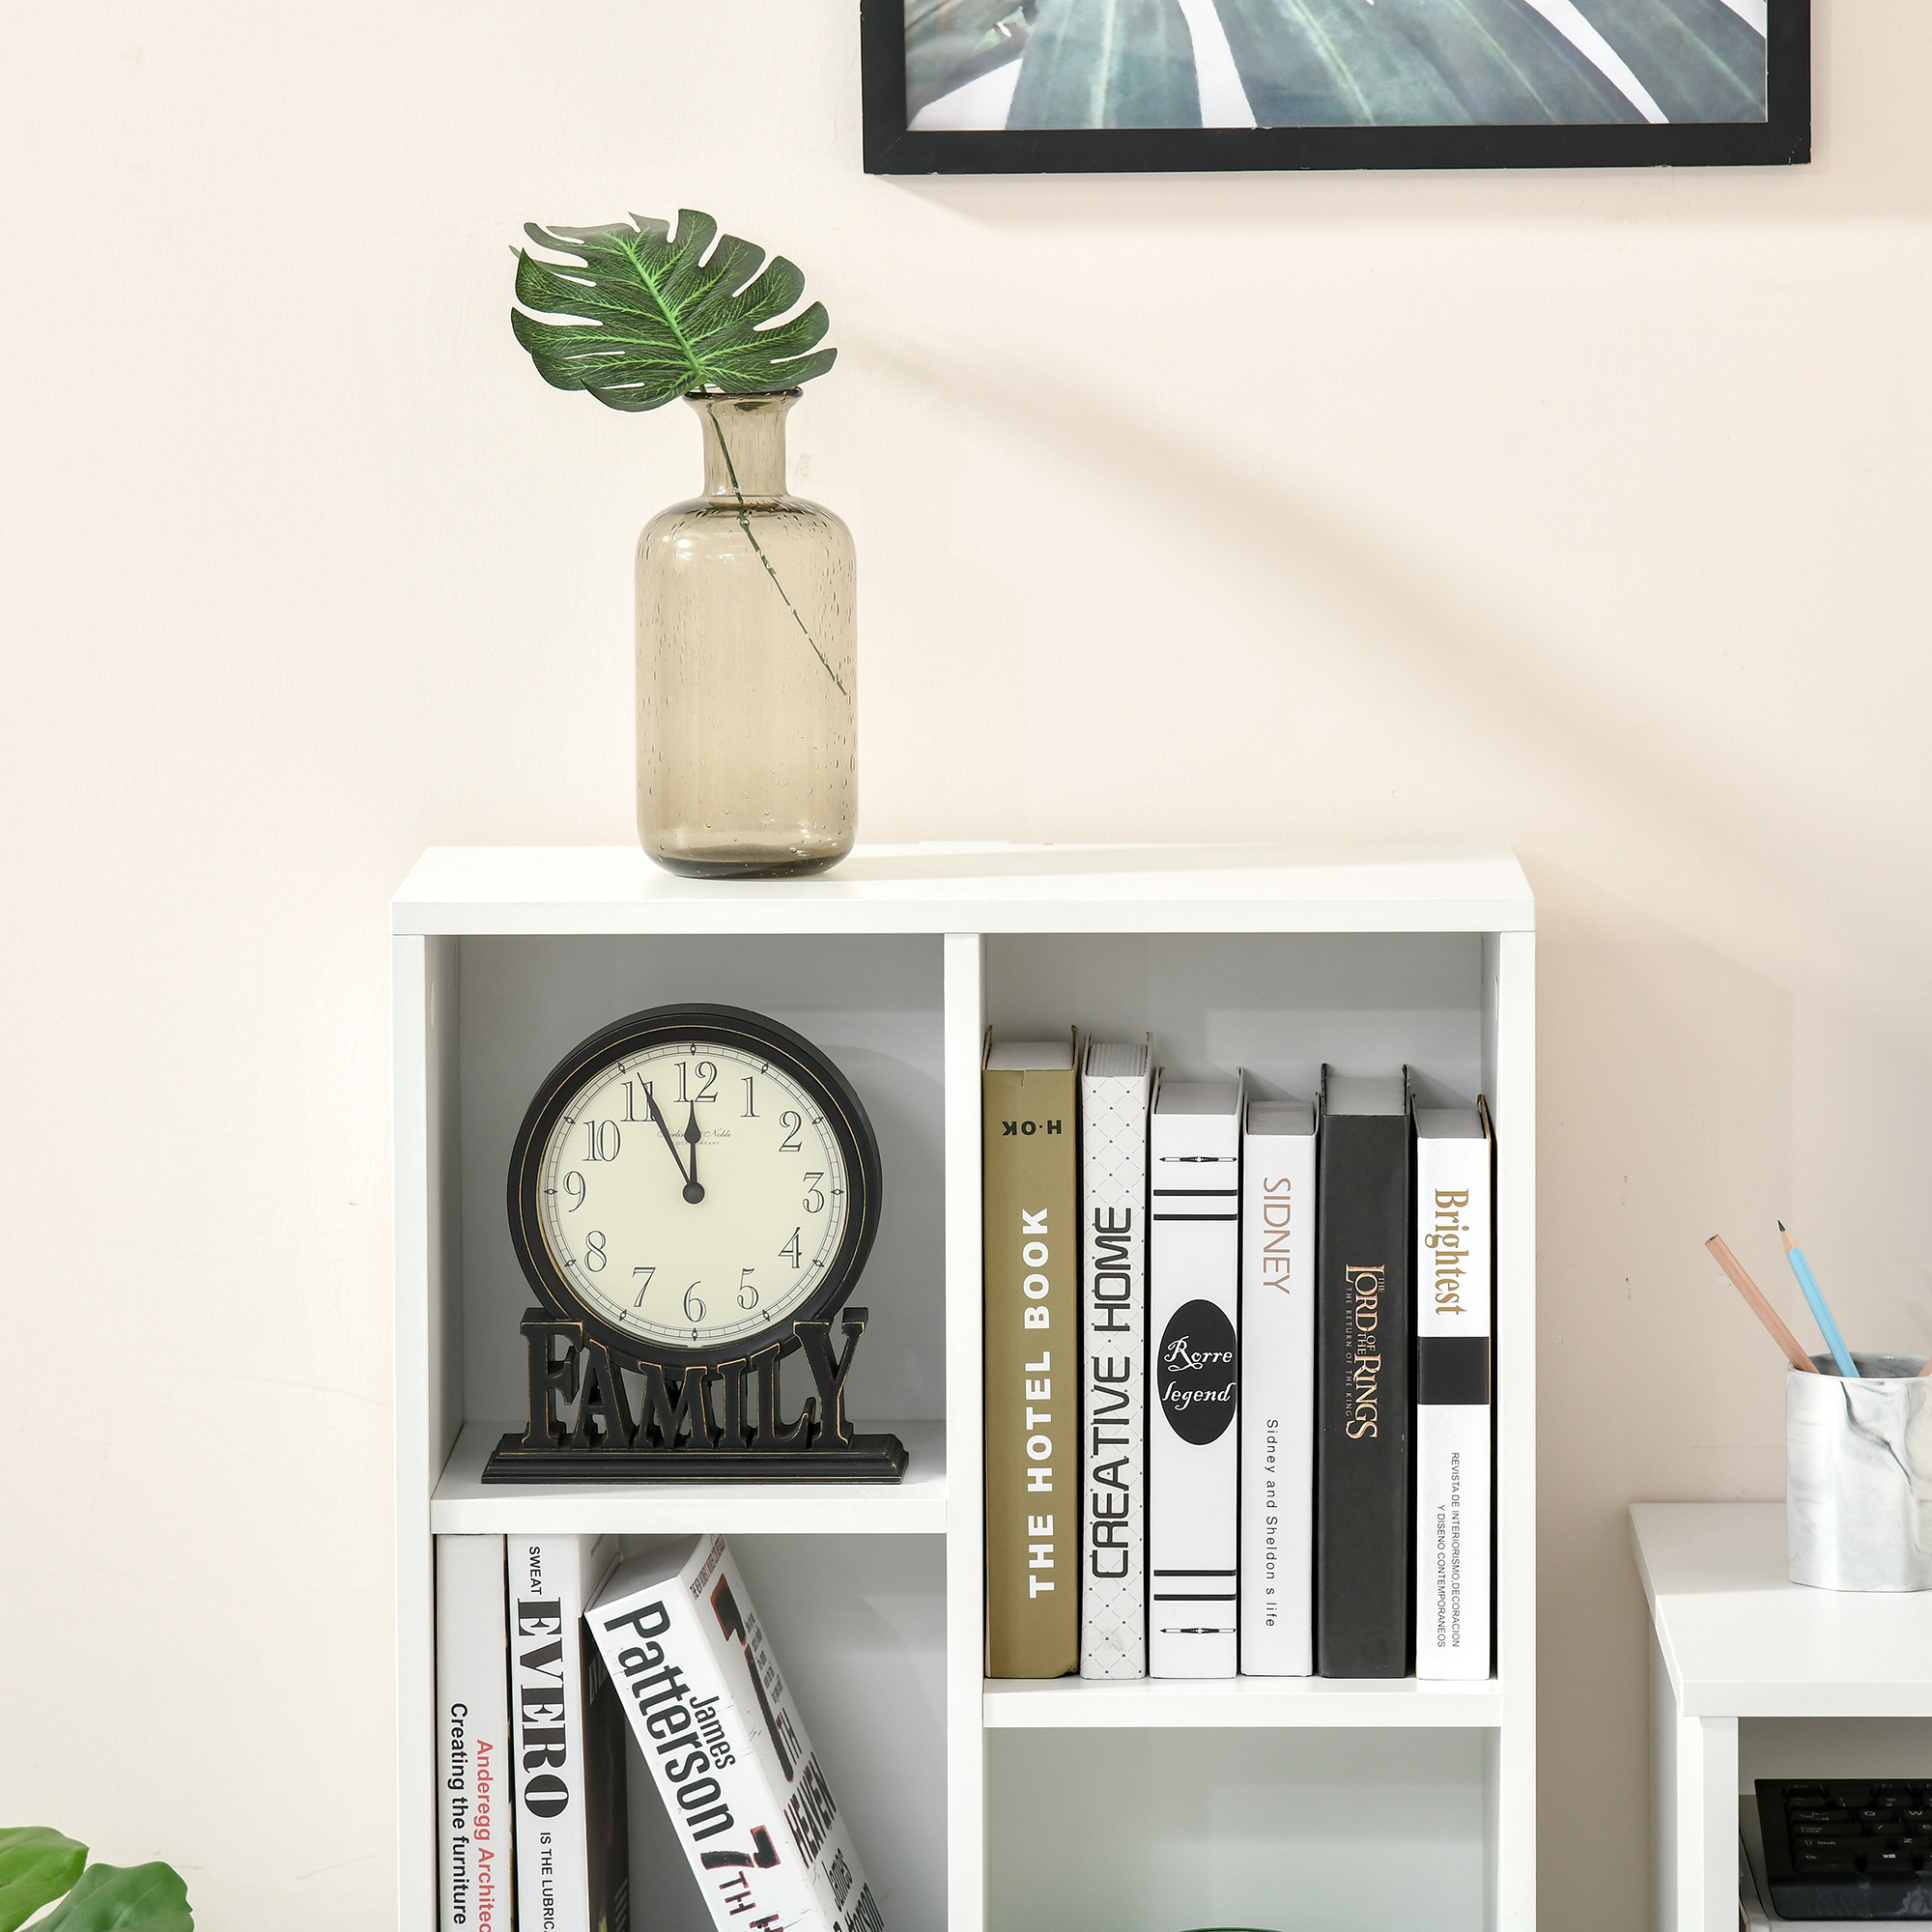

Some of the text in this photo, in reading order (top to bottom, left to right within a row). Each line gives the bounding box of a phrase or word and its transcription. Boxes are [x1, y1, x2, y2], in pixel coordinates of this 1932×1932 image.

[620, 1080, 657, 1122] 11
[673, 1061, 719, 1103] 12
[741, 1076, 760, 1118] 1
[582, 1120, 621, 1162] 10
[779, 1111, 803, 1152] 2
[562, 1170, 586, 1213] 9
[802, 1172, 825, 1214] 3
[584, 1230, 608, 1272] 8
[778, 1227, 802, 1269] 4
[1263, 1177, 1292, 1295] SIDNEY
[1426, 1187, 1470, 1316] Brightest
[632, 1266, 657, 1308] 7
[683, 1280, 707, 1323] 6
[737, 1267, 760, 1311] 5
[1345, 1263, 1385, 1332] LORD
[1163, 1335, 1234, 1373] Rorre
[1345, 1287, 1353, 1417] THE RETURN OF THE KING
[1356, 1332, 1367, 1355] THE
[1366, 1334, 1377, 1352] OF
[520, 1308, 868, 1450] FAMILY
[1092, 1207, 1132, 1578] CREATIVE HOME
[1162, 1380, 1237, 1411] legend
[1345, 1352, 1382, 1439] RINGS
[1021, 1208, 1055, 1599] THE HOTEL BOOK
[1264, 1418, 1279, 1474] Sidney
[1451, 1452, 1461, 1493] REVISTA
[1265, 1480, 1278, 1509] and
[1451, 1493, 1461, 1508] DE
[1265, 1516, 1278, 1579] Sheldon
[1436, 1513, 1446, 1550] DISENO
[1265, 1602, 1278, 1628] life
[1436, 1551, 1446, 1648] CONTEMPORANEOS
[517, 1546, 570, 1932] SWEAT EVERO IS THE LUBRIC
[603, 1600, 735, 1842] Patterson
[689, 1694, 737, 1770] James
[446, 1702, 470, 1925] Creating the furniture
[782, 1750, 838, 1870] HEAVEN
[472, 1739, 496, 1932] Anderegg Architec
[820, 1847, 853, 1913] James
